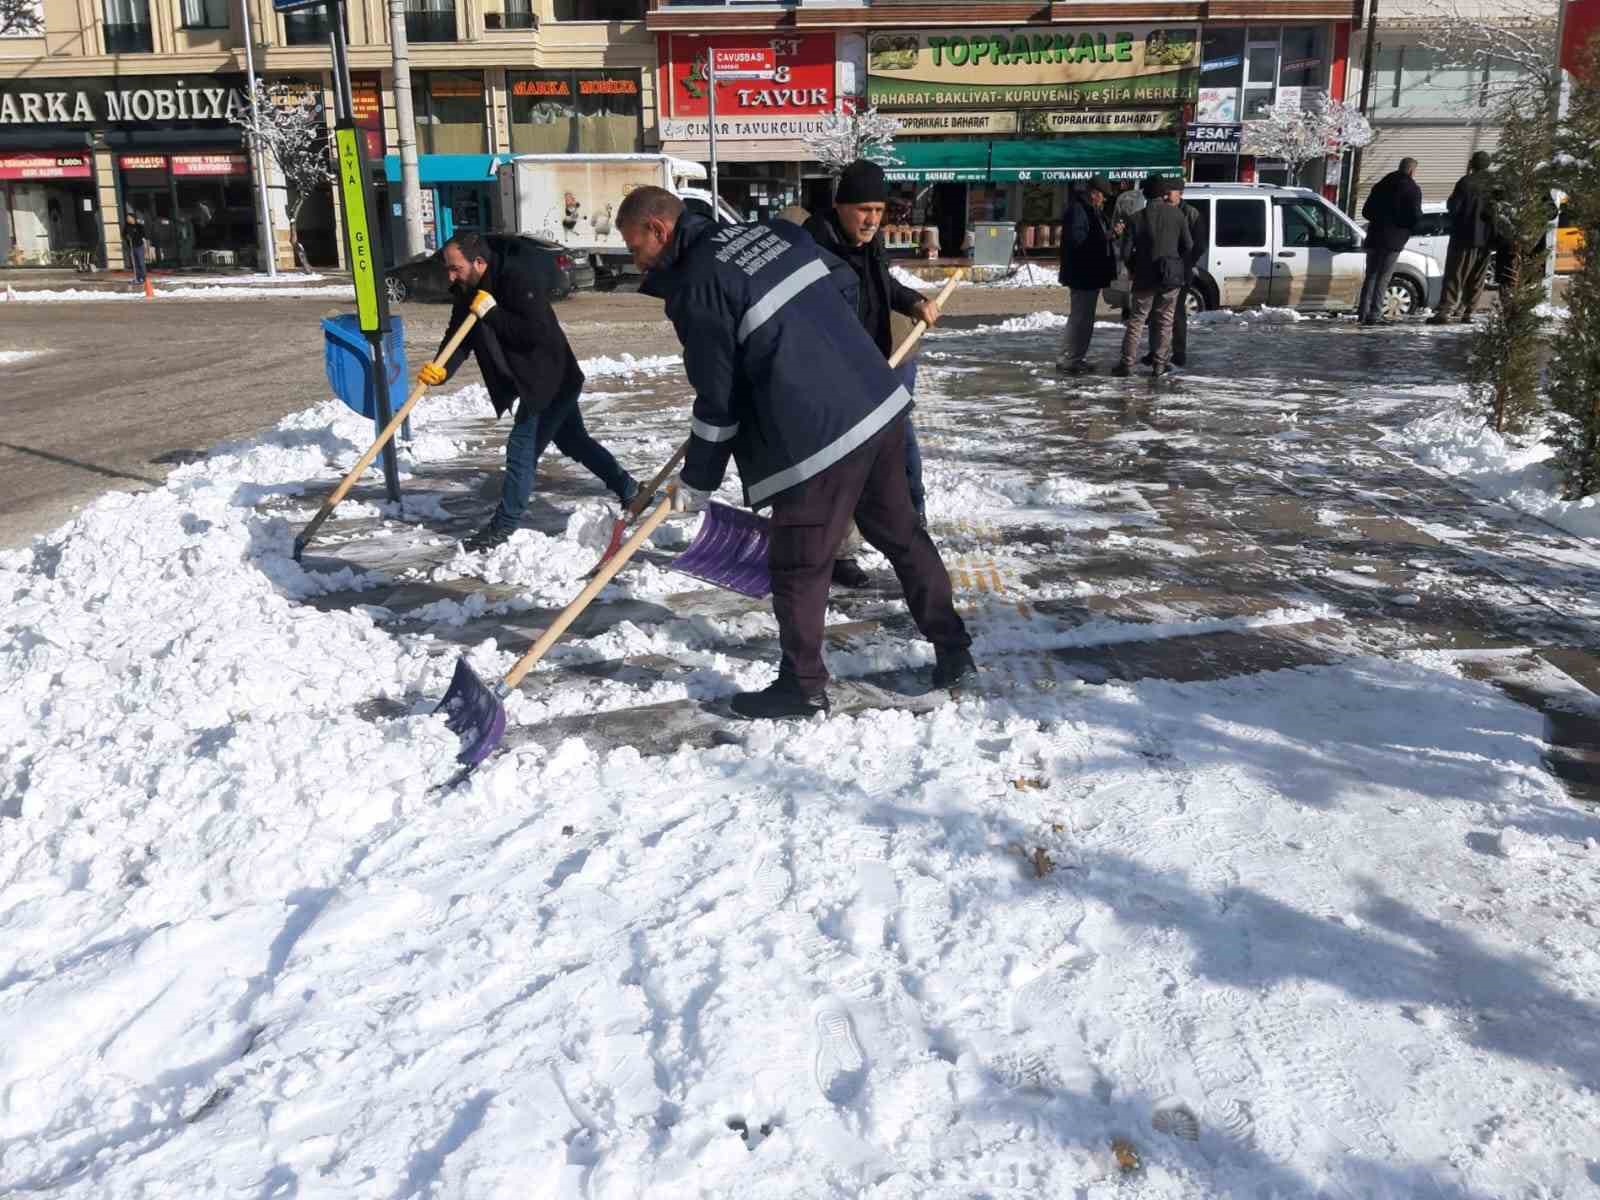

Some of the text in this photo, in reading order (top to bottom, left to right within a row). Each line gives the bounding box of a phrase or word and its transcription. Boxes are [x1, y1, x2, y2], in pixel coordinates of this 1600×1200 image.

[928, 31, 1133, 66] TOPRAKKALE
[0, 91, 96, 123] ARKA
[737, 87, 829, 107] TAVUK
[1052, 113, 1159, 125] TOPRAKKALE BAHARAT
[711, 224, 749, 242] VAN
